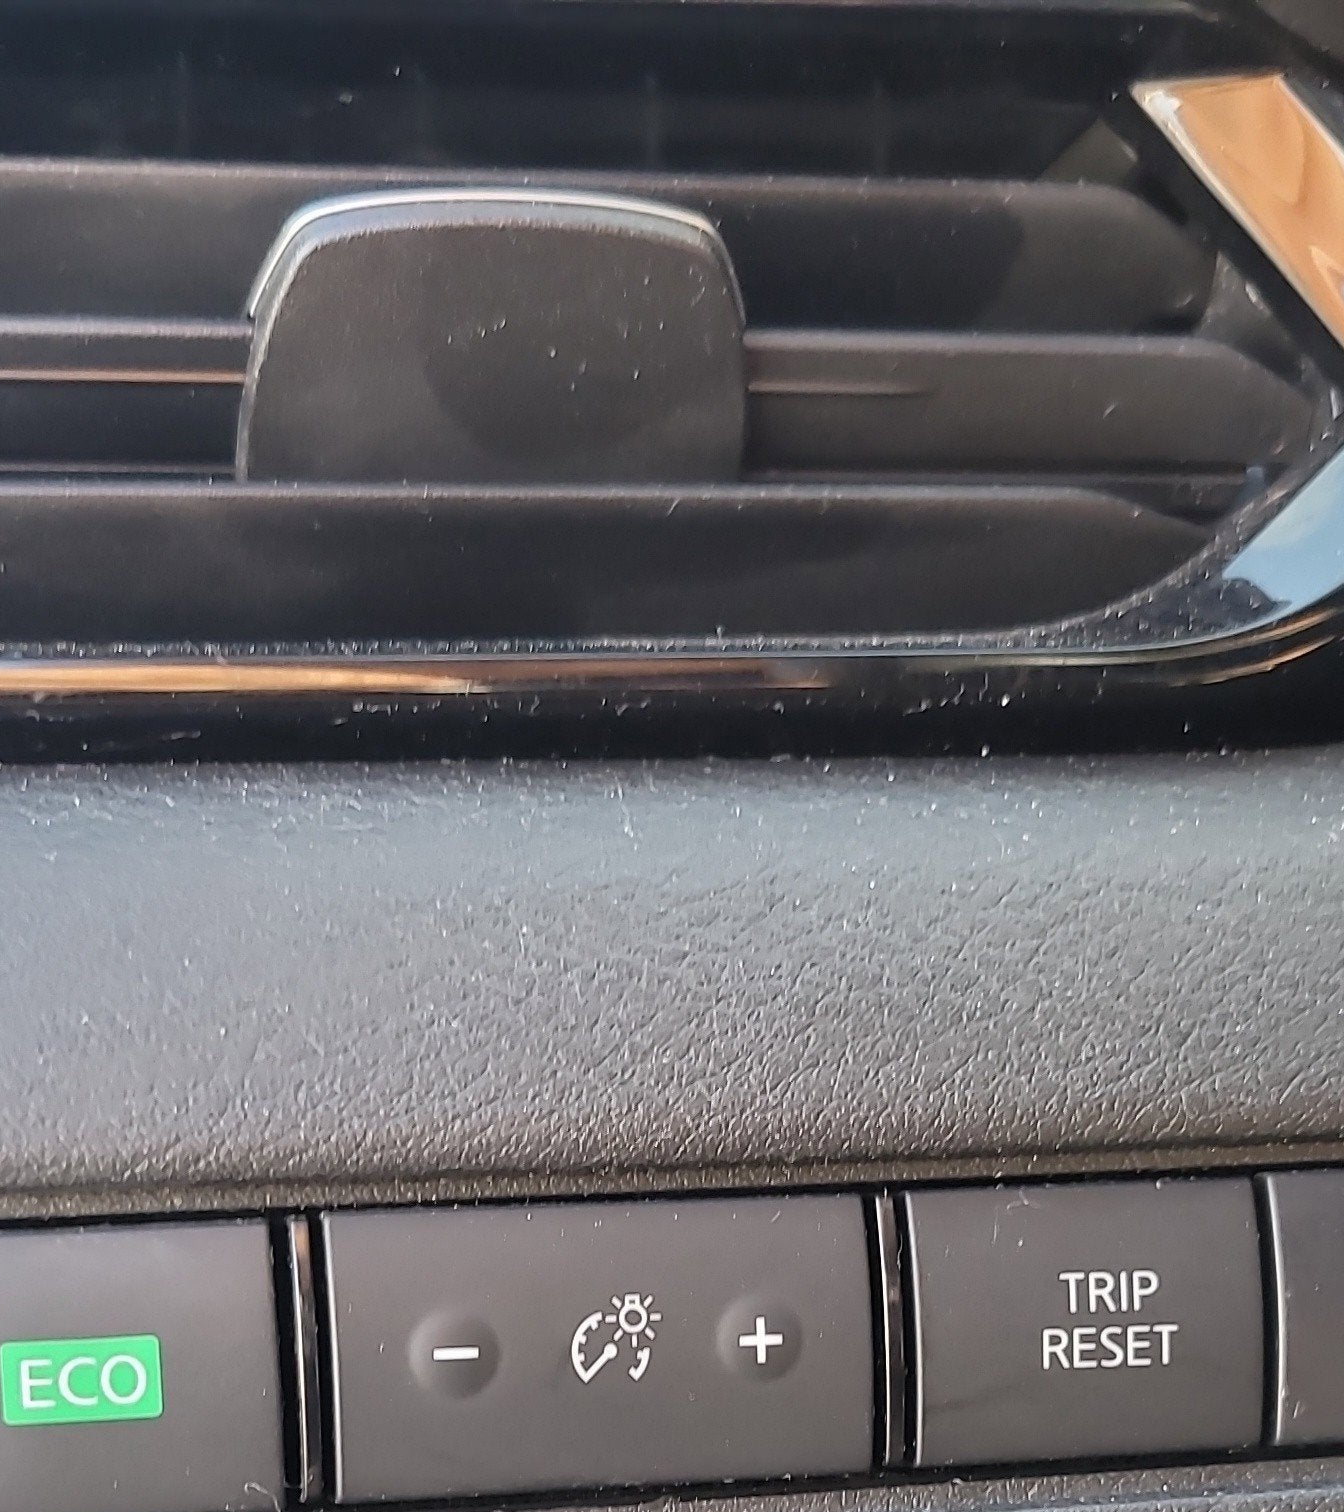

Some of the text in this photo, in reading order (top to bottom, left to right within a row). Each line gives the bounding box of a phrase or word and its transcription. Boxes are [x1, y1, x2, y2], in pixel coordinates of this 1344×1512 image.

[1058, 1269, 1161, 1314] TRIP
[1042, 1323, 1180, 1370] RESET
[18, 1354, 148, 1410] ECO
